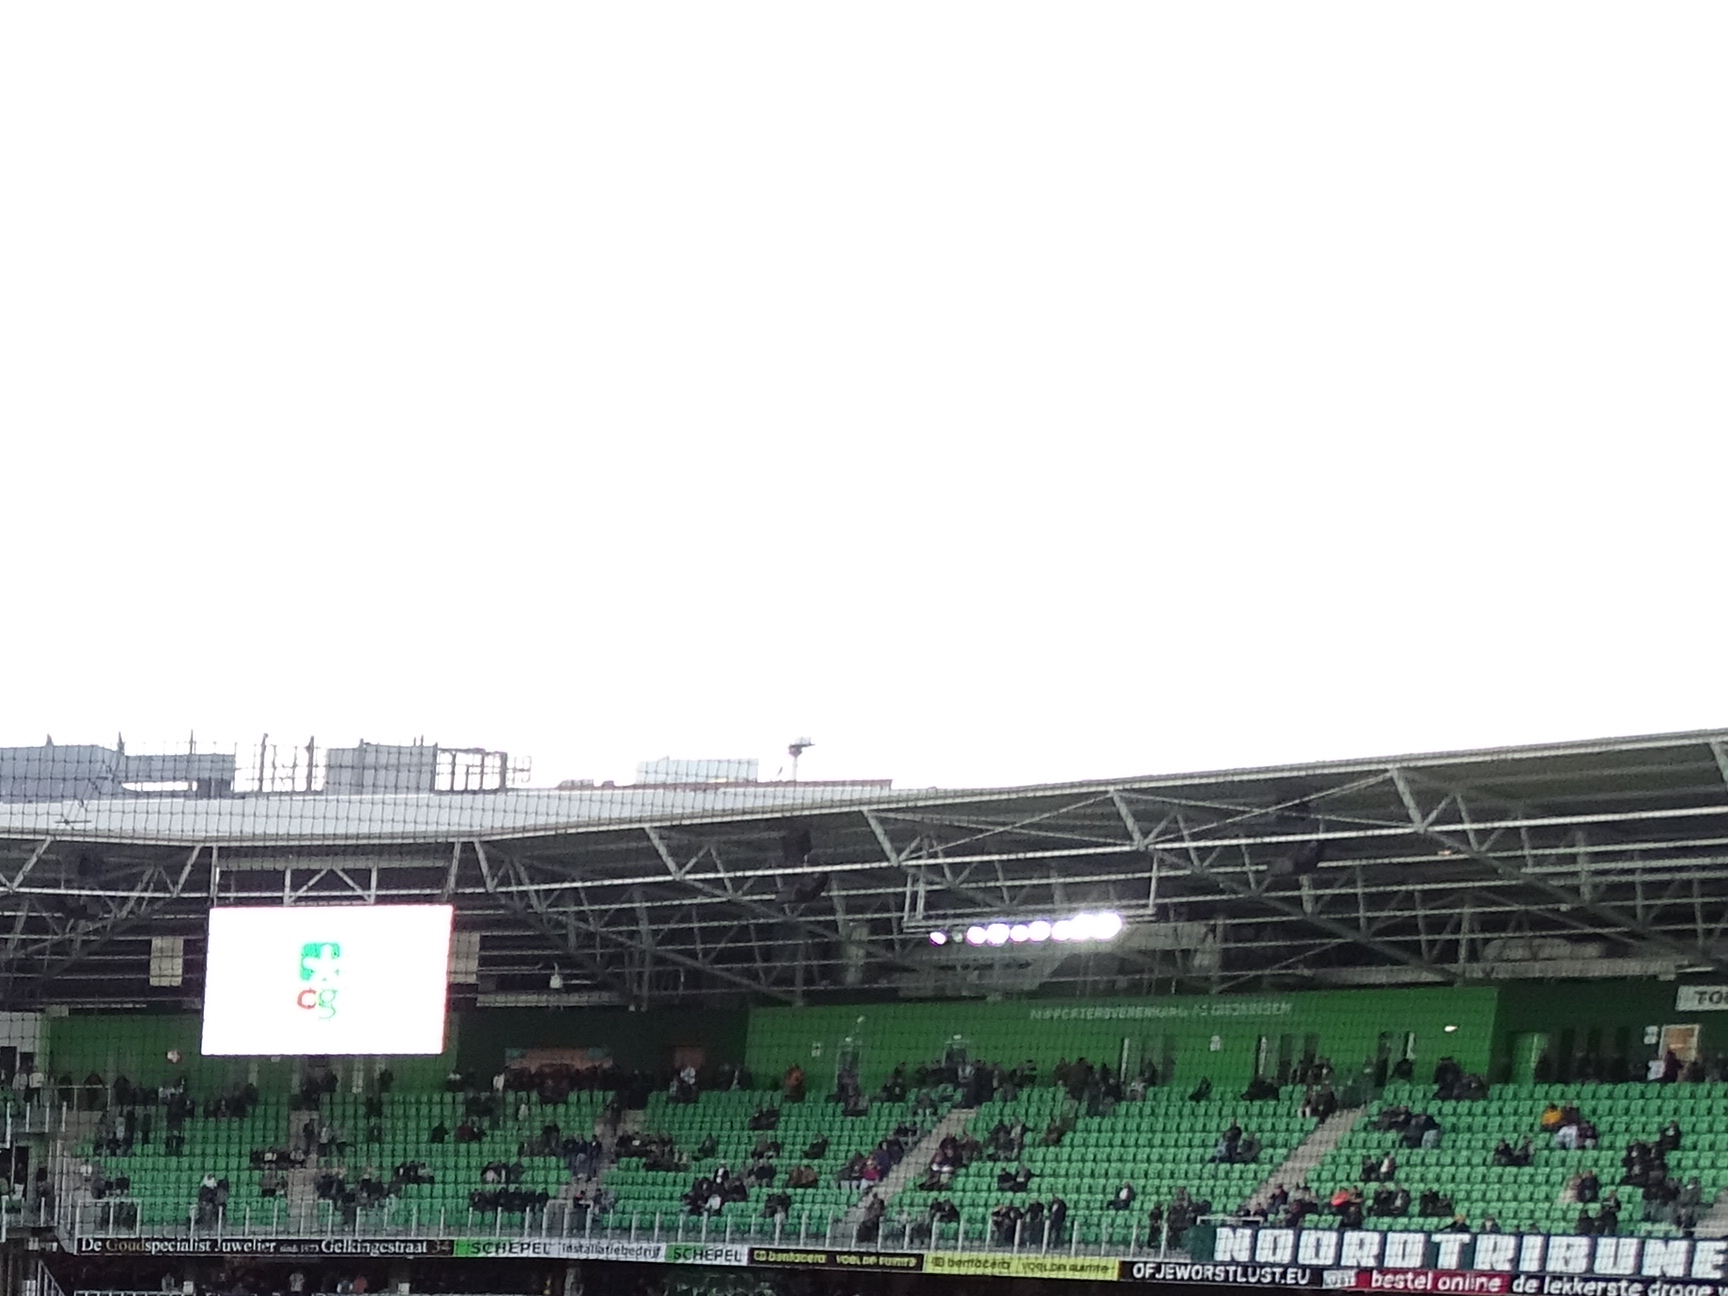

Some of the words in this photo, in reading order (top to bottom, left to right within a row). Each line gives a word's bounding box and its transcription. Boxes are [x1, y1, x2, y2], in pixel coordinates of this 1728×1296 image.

[81, 1238, 102, 1253] De
[105, 1237, 211, 1256] Goudspecialist
[215, 1239, 277, 1253] Juwelier
[321, 1238, 428, 1256] Gelkingestraat
[470, 1240, 550, 1257] SCHEPEL
[673, 1248, 742, 1264] SCHEPEL
[1132, 1263, 1311, 1285] OFJEWORSTLUST.EU
[1371, 1270, 1433, 1290] bestel
[1437, 1272, 1503, 1293] online
[1513, 1275, 1539, 1295] de
